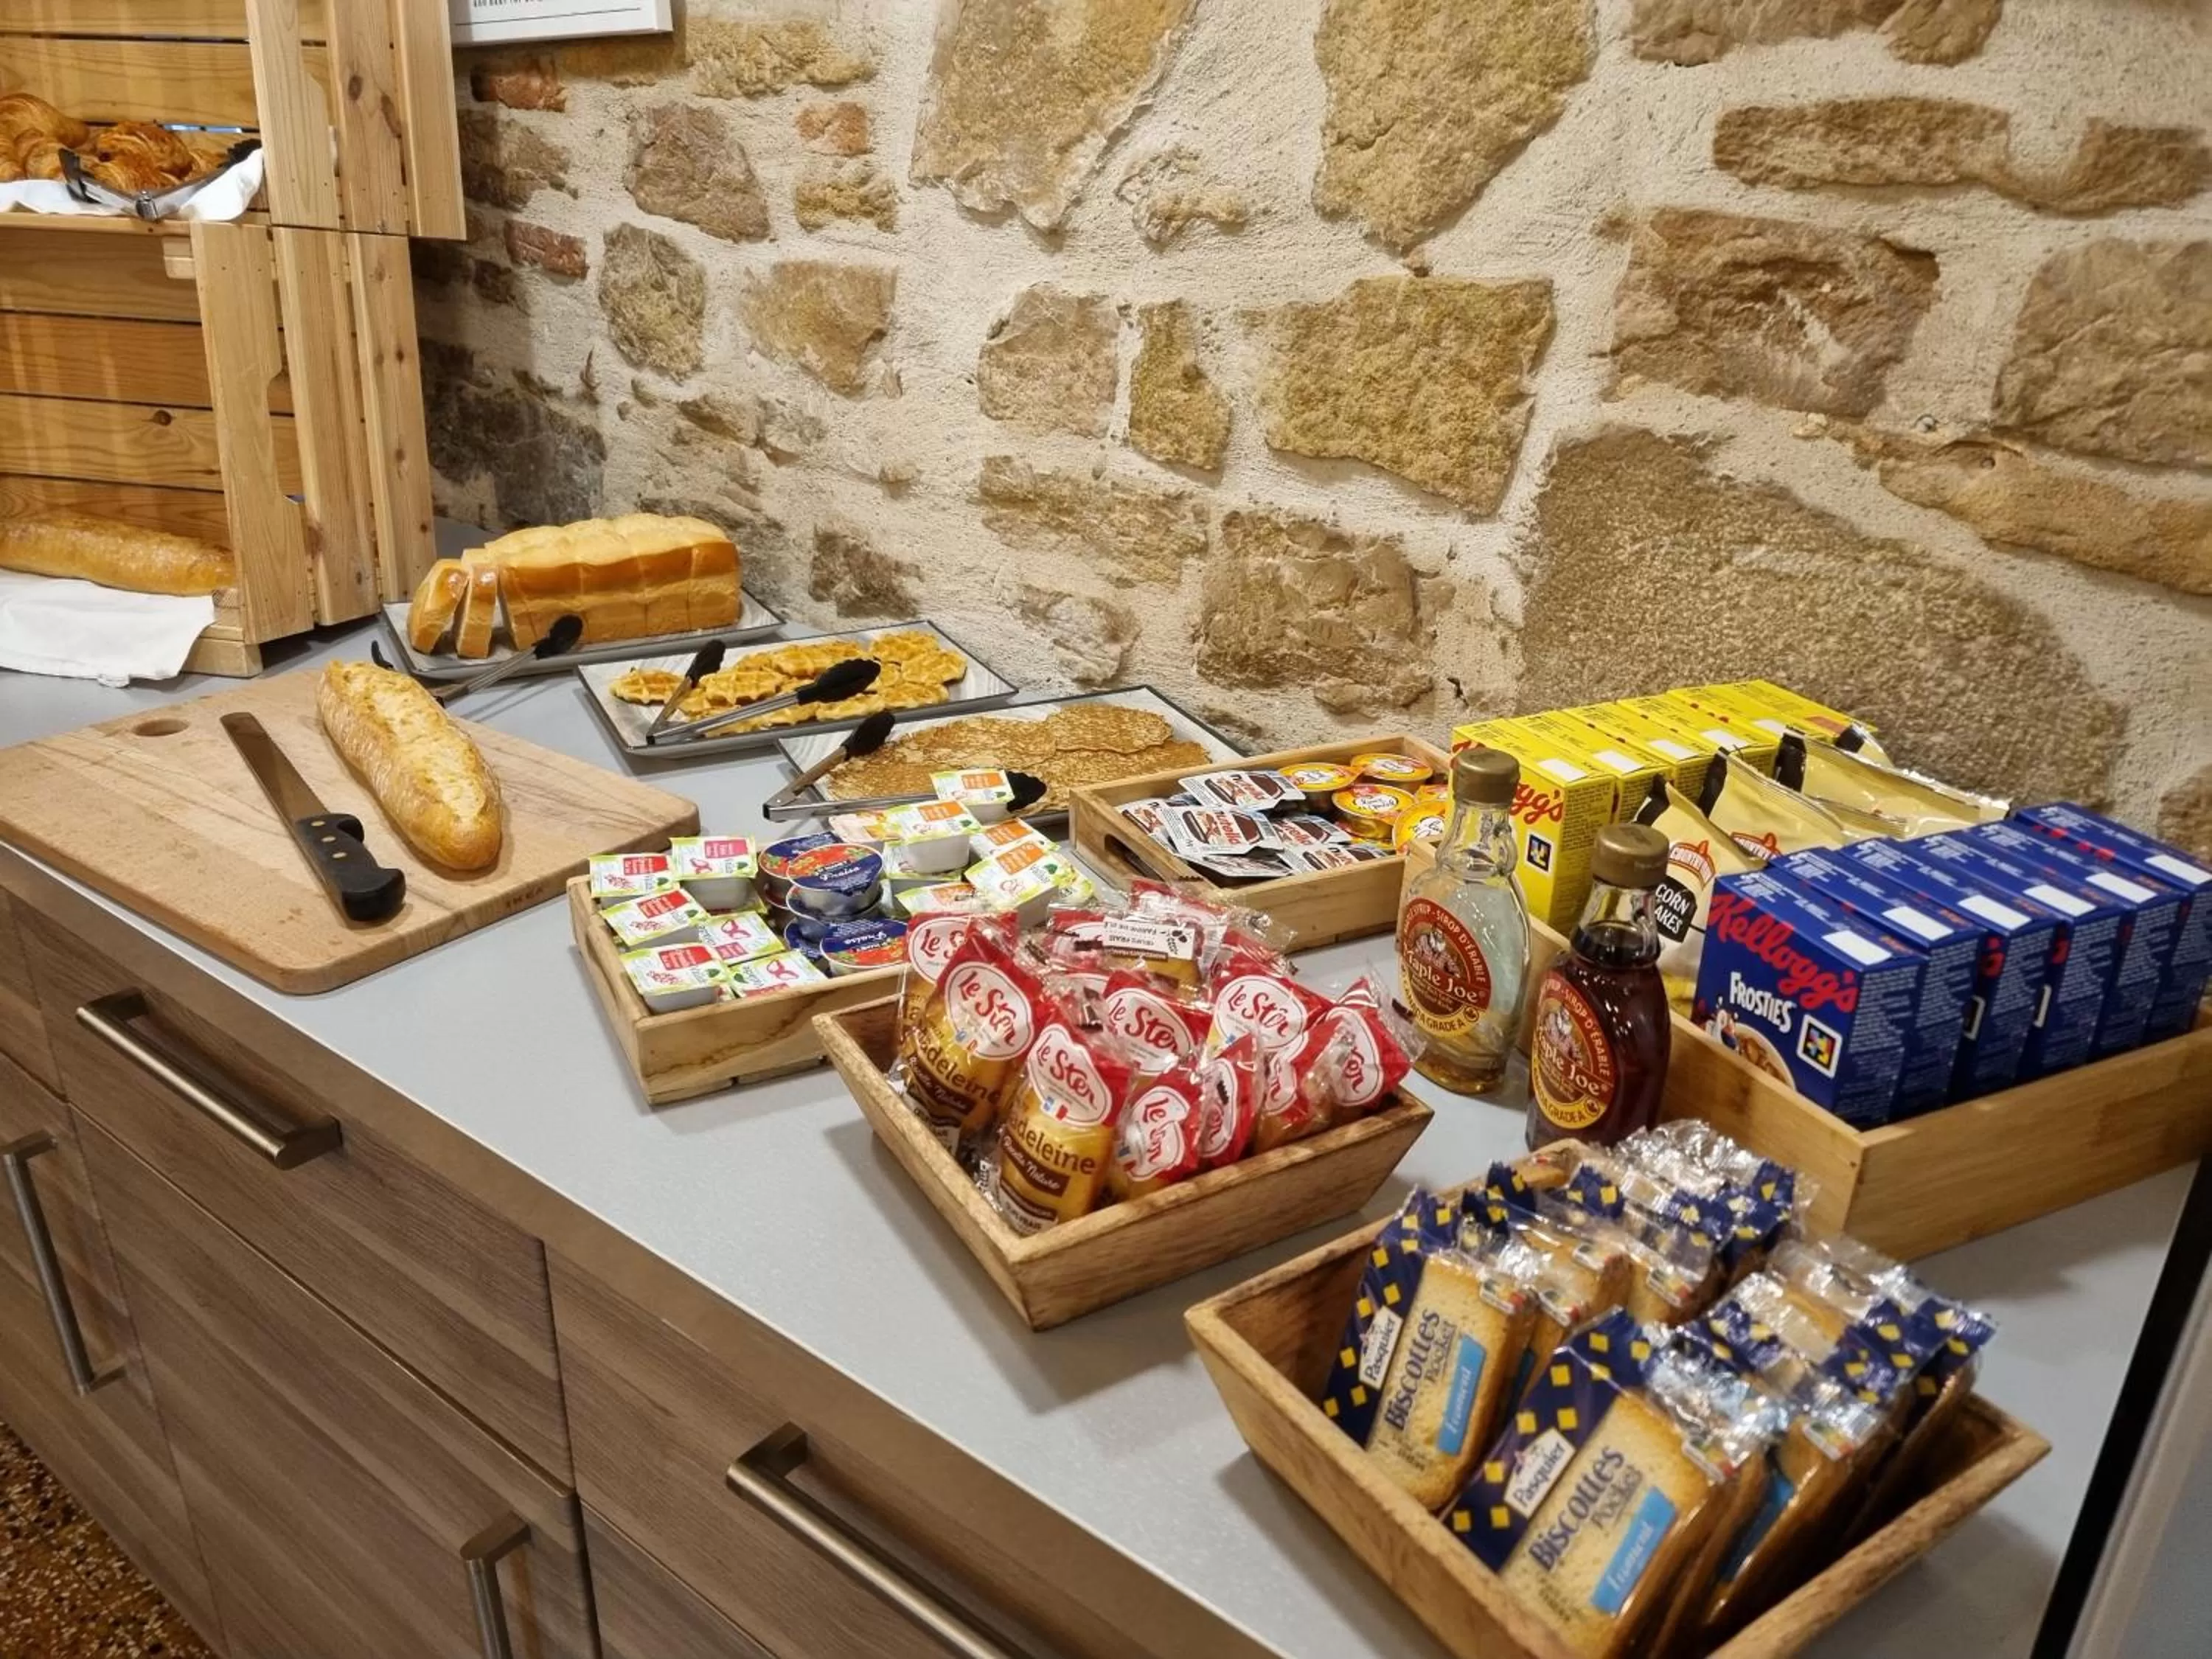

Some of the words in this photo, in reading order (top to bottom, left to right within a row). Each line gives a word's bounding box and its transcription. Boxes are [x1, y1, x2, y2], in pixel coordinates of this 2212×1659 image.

[1654, 905, 1683, 934] AKES
[1655, 883, 1690, 915] CORN
[1708, 892, 1859, 1013] Kellogg's
[1447, 978, 1478, 1004] Joe
[1729, 971, 1793, 1033] FROSTIES
[1569, 1063, 1600, 1096] Joe
[1013, 1116, 1096, 1175] deleine
[1364, 1317, 1397, 1382] Pasquier
[1512, 1441, 1566, 1508] Pasquier
